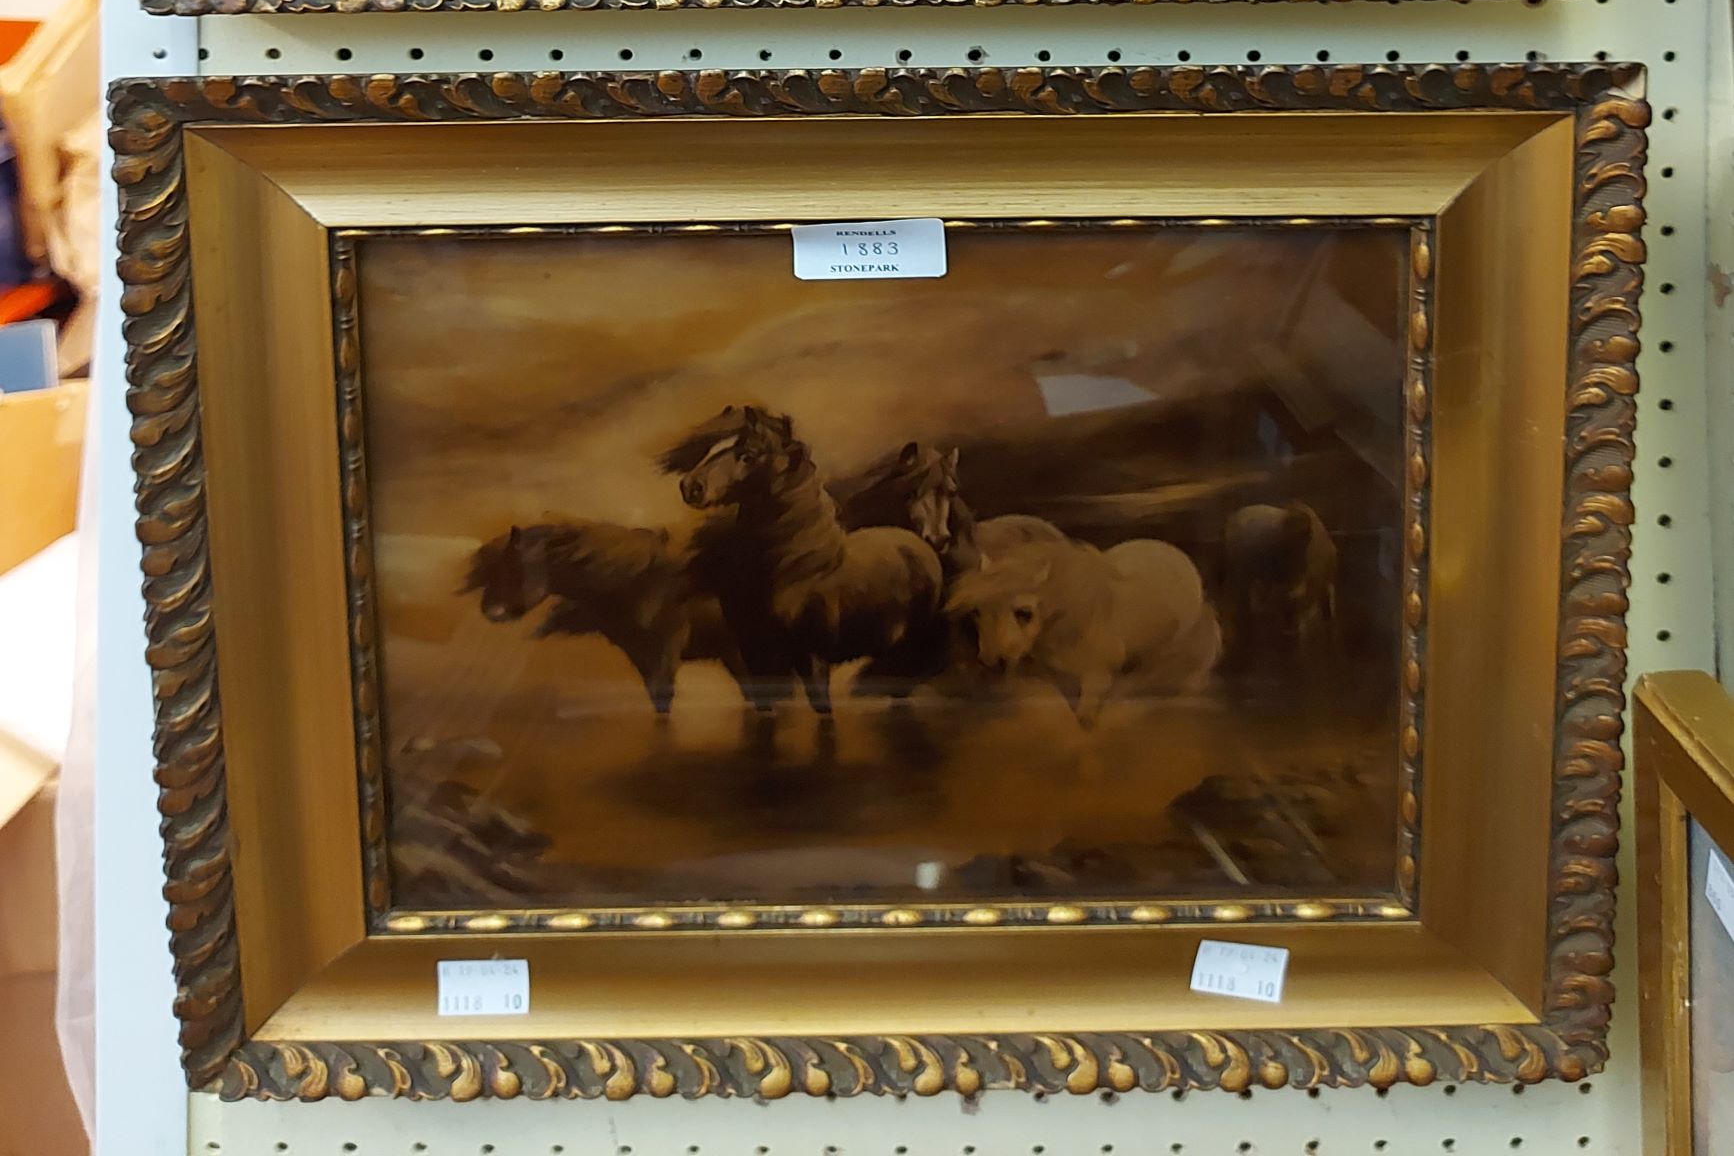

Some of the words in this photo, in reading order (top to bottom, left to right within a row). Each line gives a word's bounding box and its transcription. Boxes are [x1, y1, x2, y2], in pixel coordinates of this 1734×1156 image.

[835, 229, 897, 237] RENDELLS
[842, 241, 899, 257] 1883
[830, 264, 900, 273] STONEPARK
[1257, 979, 1275, 998] 10
[504, 993, 522, 1010] 10
